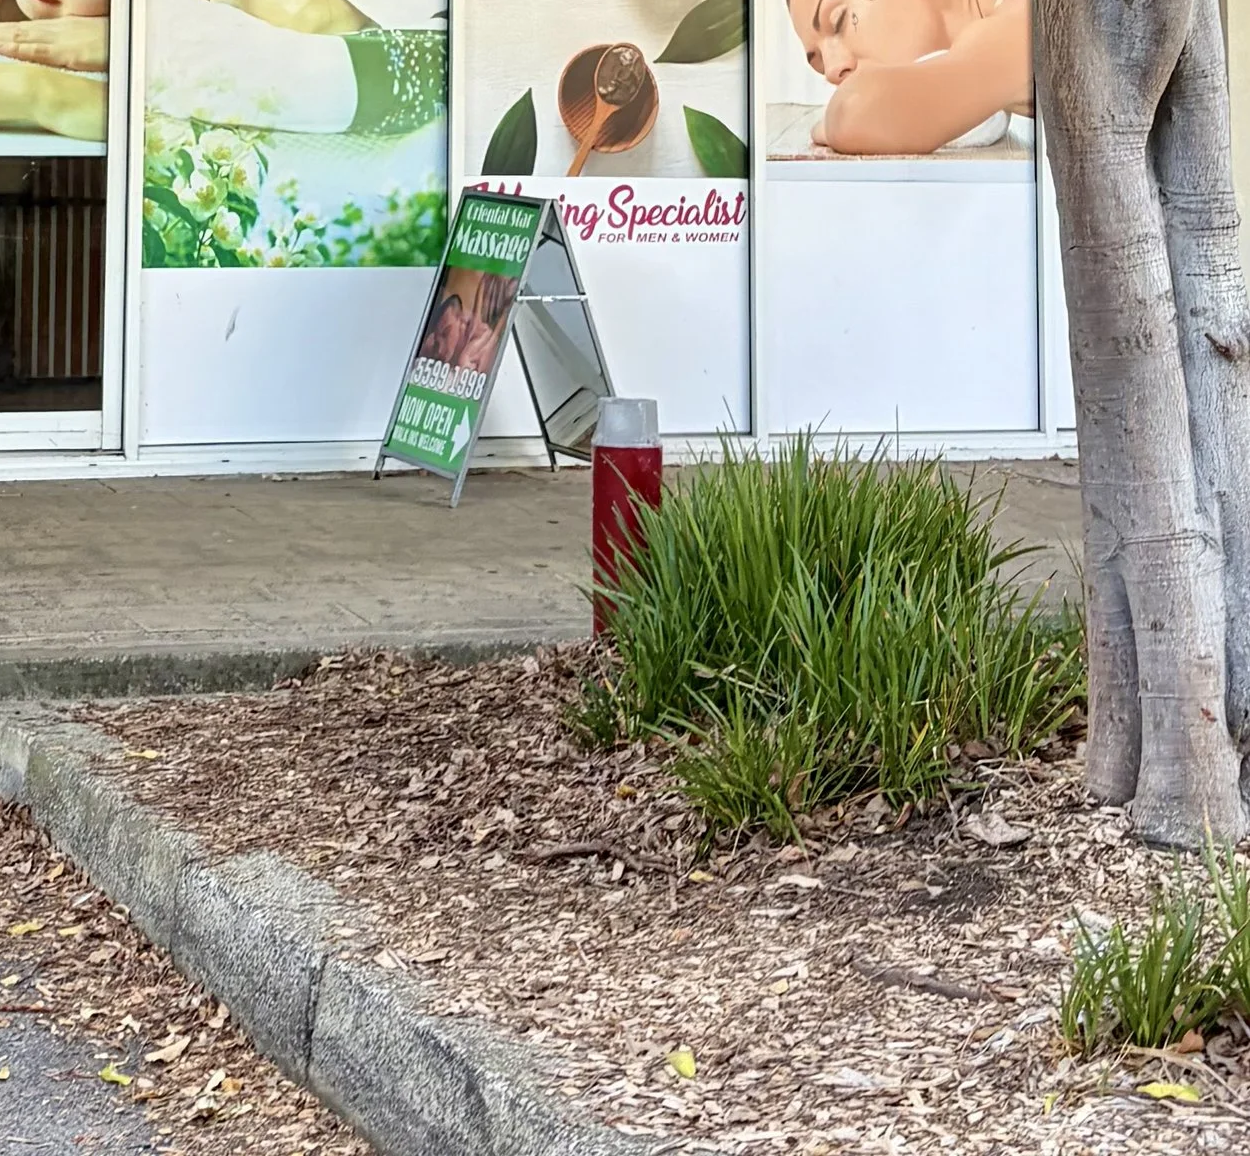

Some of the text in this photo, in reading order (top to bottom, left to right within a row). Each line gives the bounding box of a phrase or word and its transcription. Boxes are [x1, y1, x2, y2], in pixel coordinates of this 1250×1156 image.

[467, 202, 535, 229] Oriental Star
[607, 185, 746, 240] Specialist
[451, 222, 530, 263] Massage
[598, 232, 740, 243] FOR MEN & WOMEN
[413, 356, 487, 401] 5599 1998
[397, 394, 456, 437] NOW OPEN
